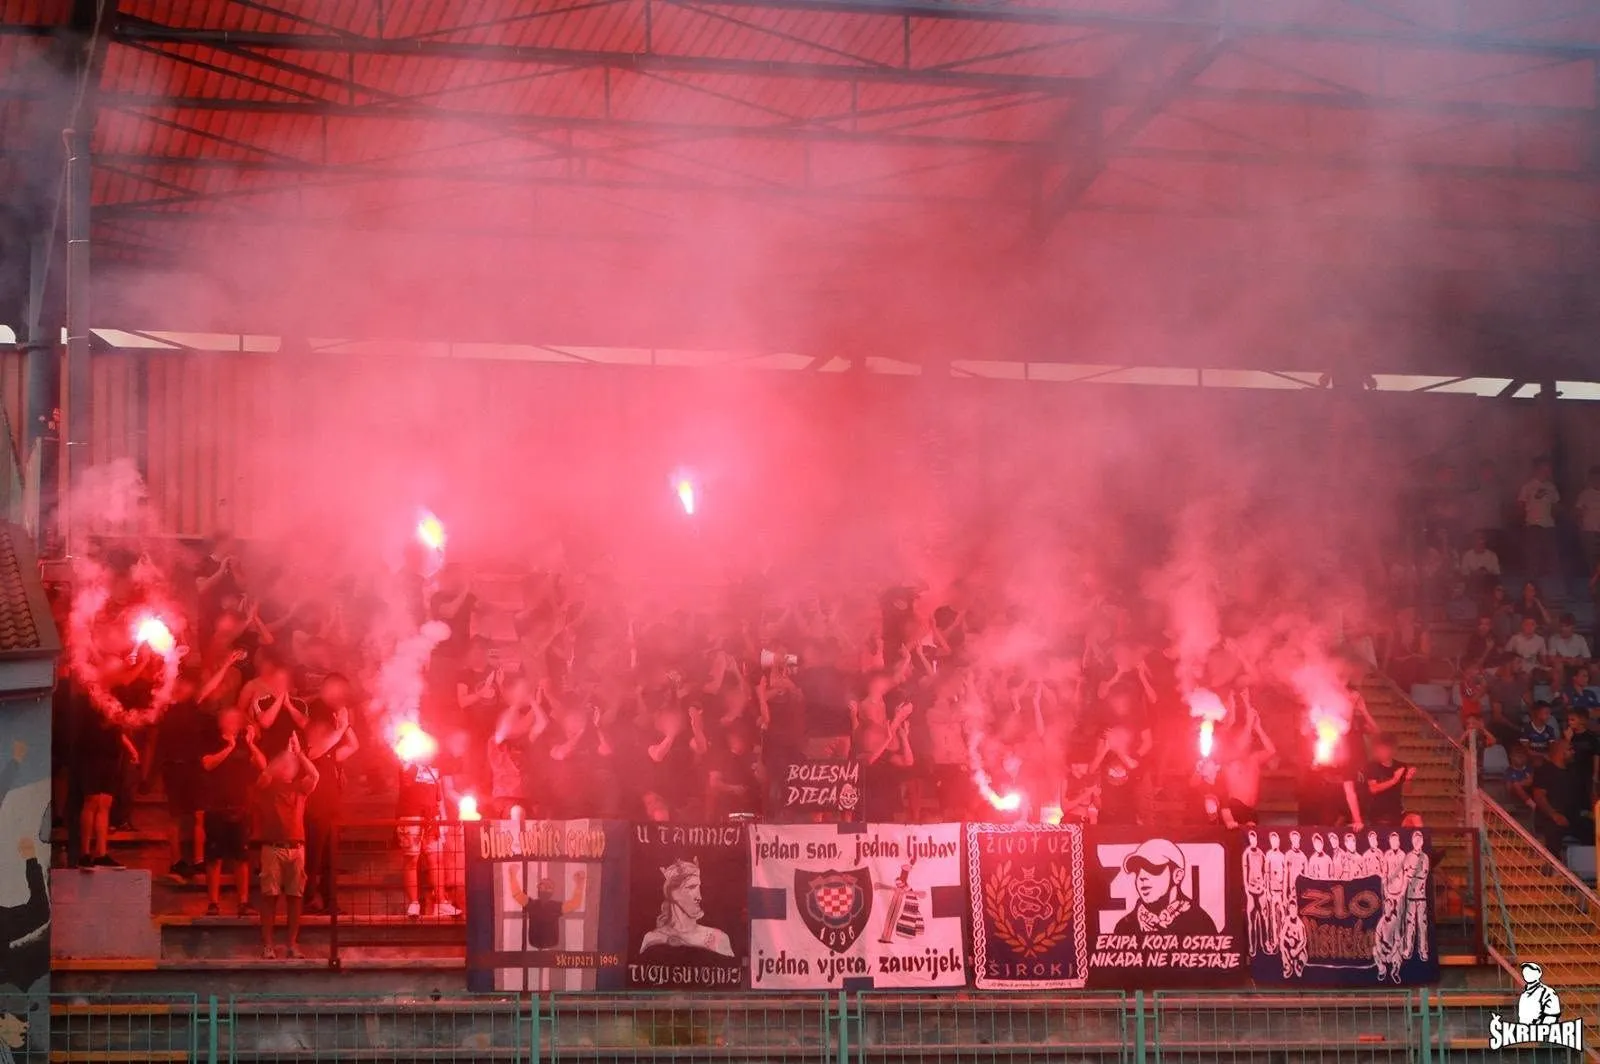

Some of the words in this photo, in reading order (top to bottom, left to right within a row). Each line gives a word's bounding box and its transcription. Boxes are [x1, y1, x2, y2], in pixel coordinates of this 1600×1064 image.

[786, 760, 859, 784] BOLESNA
[785, 785, 837, 806] DJECA
[755, 836, 800, 865] jedan
[854, 835, 899, 865] jedna
[906, 836, 957, 865] ljubav
[820, 926, 855, 946] 1996
[1096, 935, 1138, 950] EKIPA
[1142, 935, 1179, 950] KOJA
[1182, 935, 1233, 951] OSTAJE
[756, 951, 809, 983] jedna
[879, 948, 962, 980] zauvijek
[1089, 952, 1143, 967] NIKADA
[1147, 952, 1167, 967] NE
[1171, 952, 1240, 969] PRESTAJE
